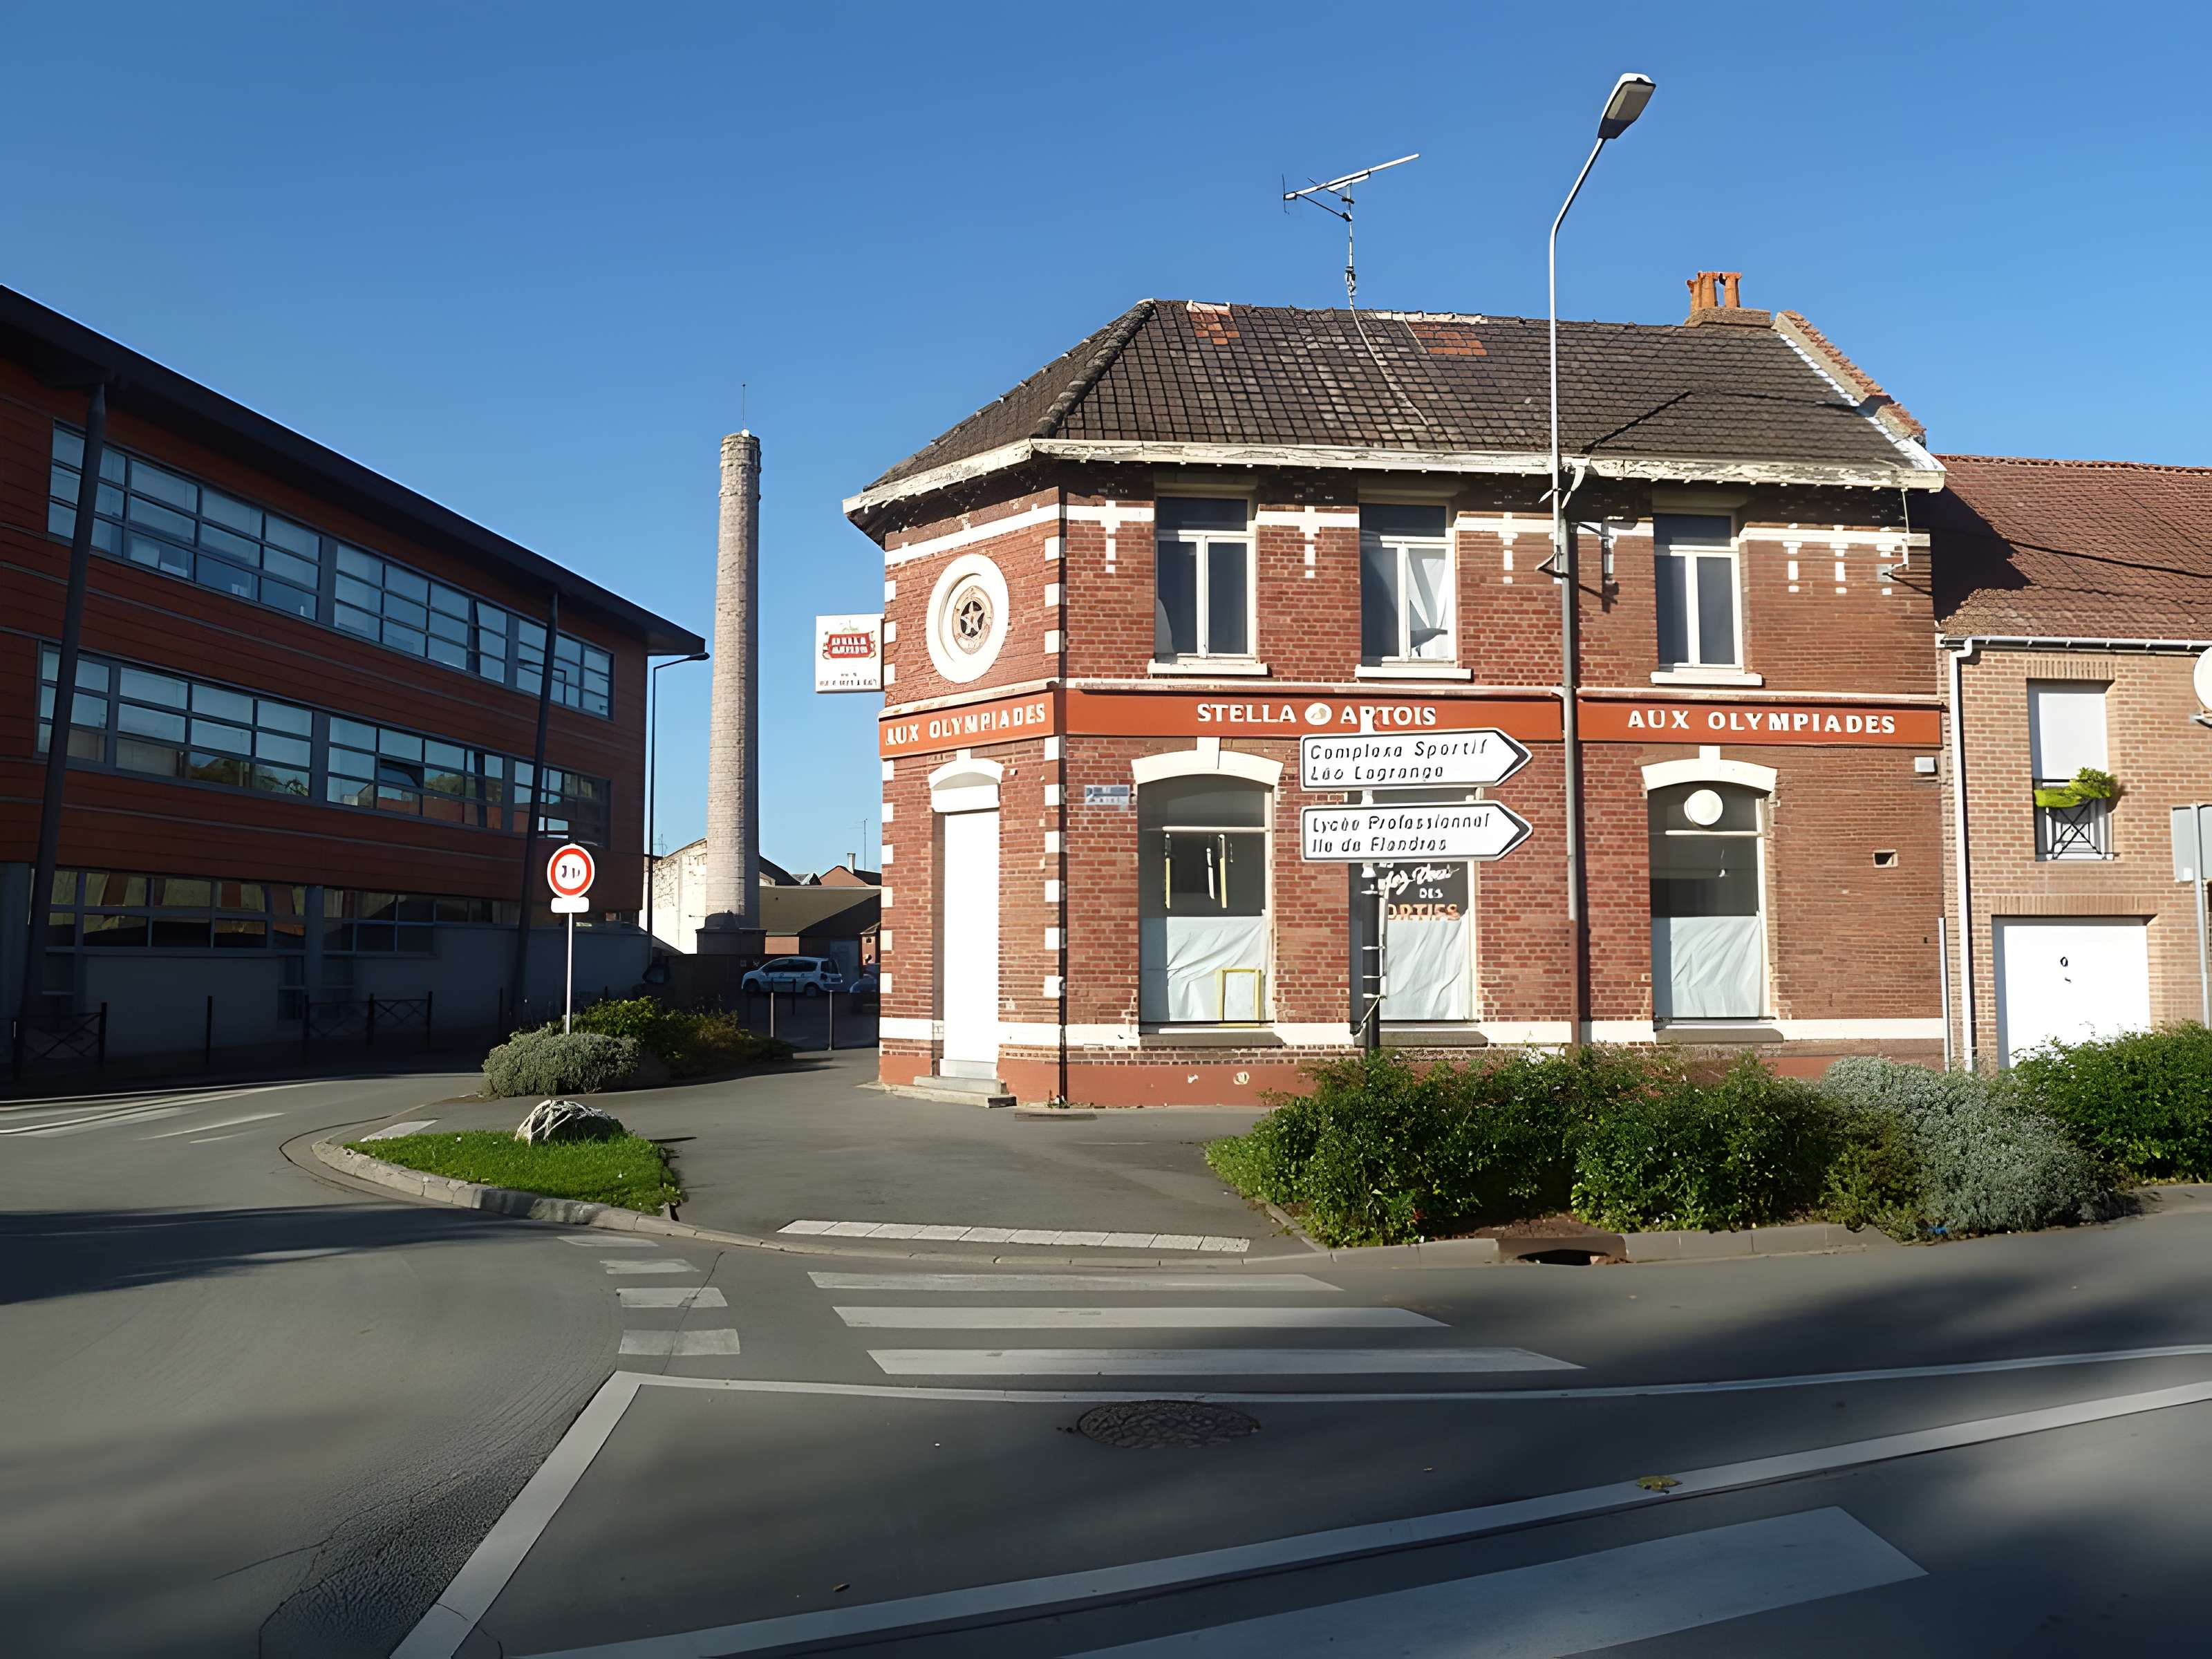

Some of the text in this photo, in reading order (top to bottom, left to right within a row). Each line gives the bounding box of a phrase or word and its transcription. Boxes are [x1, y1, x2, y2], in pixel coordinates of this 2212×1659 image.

[885, 702, 1045, 746] AUX OLYMPIADES
[1197, 703, 1297, 723] STELLA
[1627, 709, 1895, 734] AUX OLYMPIADES
